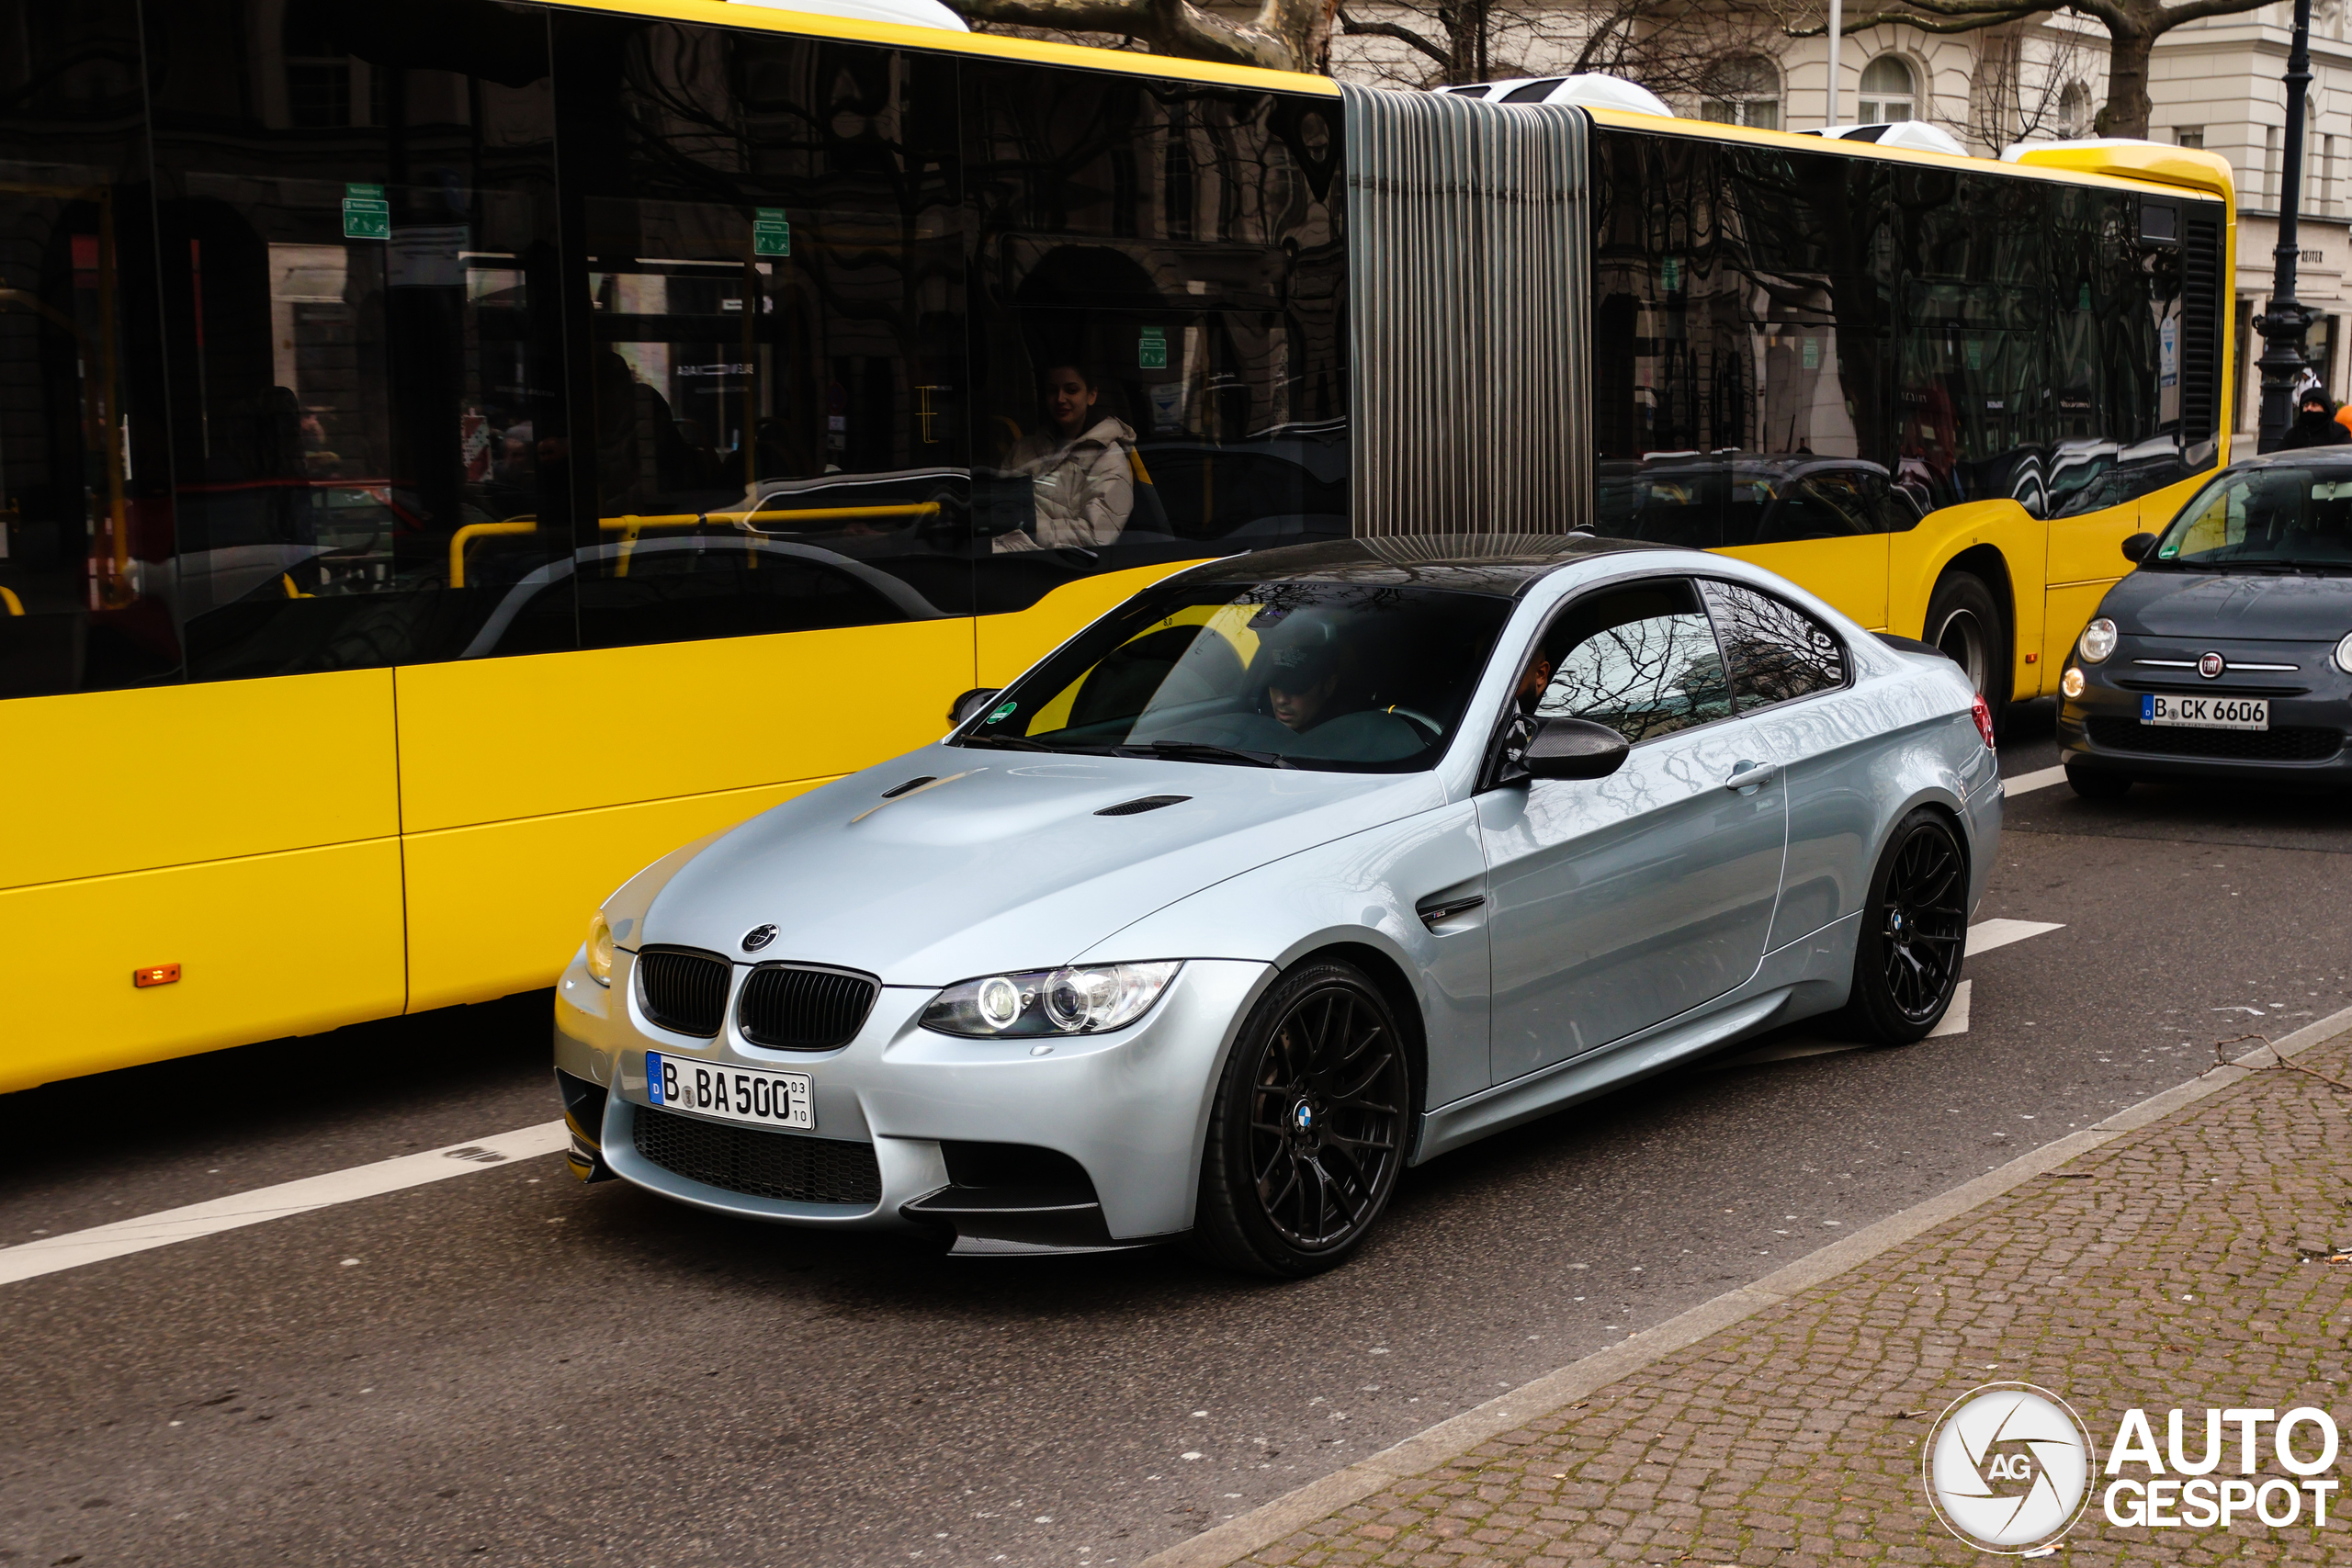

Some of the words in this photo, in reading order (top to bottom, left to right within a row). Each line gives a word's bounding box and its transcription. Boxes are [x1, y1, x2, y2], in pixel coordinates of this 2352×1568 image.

[2203, 660, 2218, 671] FIAT
[2154, 698, 2167, 717] B
[2181, 699, 2207, 719] CK
[2213, 701, 2265, 722] 6606
[653, 1083, 660, 1095] D
[662, 1061, 680, 1101] B
[695, 1068, 729, 1112] BA
[736, 1074, 790, 1120] 500
[791, 1081, 806, 1094] 03
[794, 1110, 807, 1122] 10
